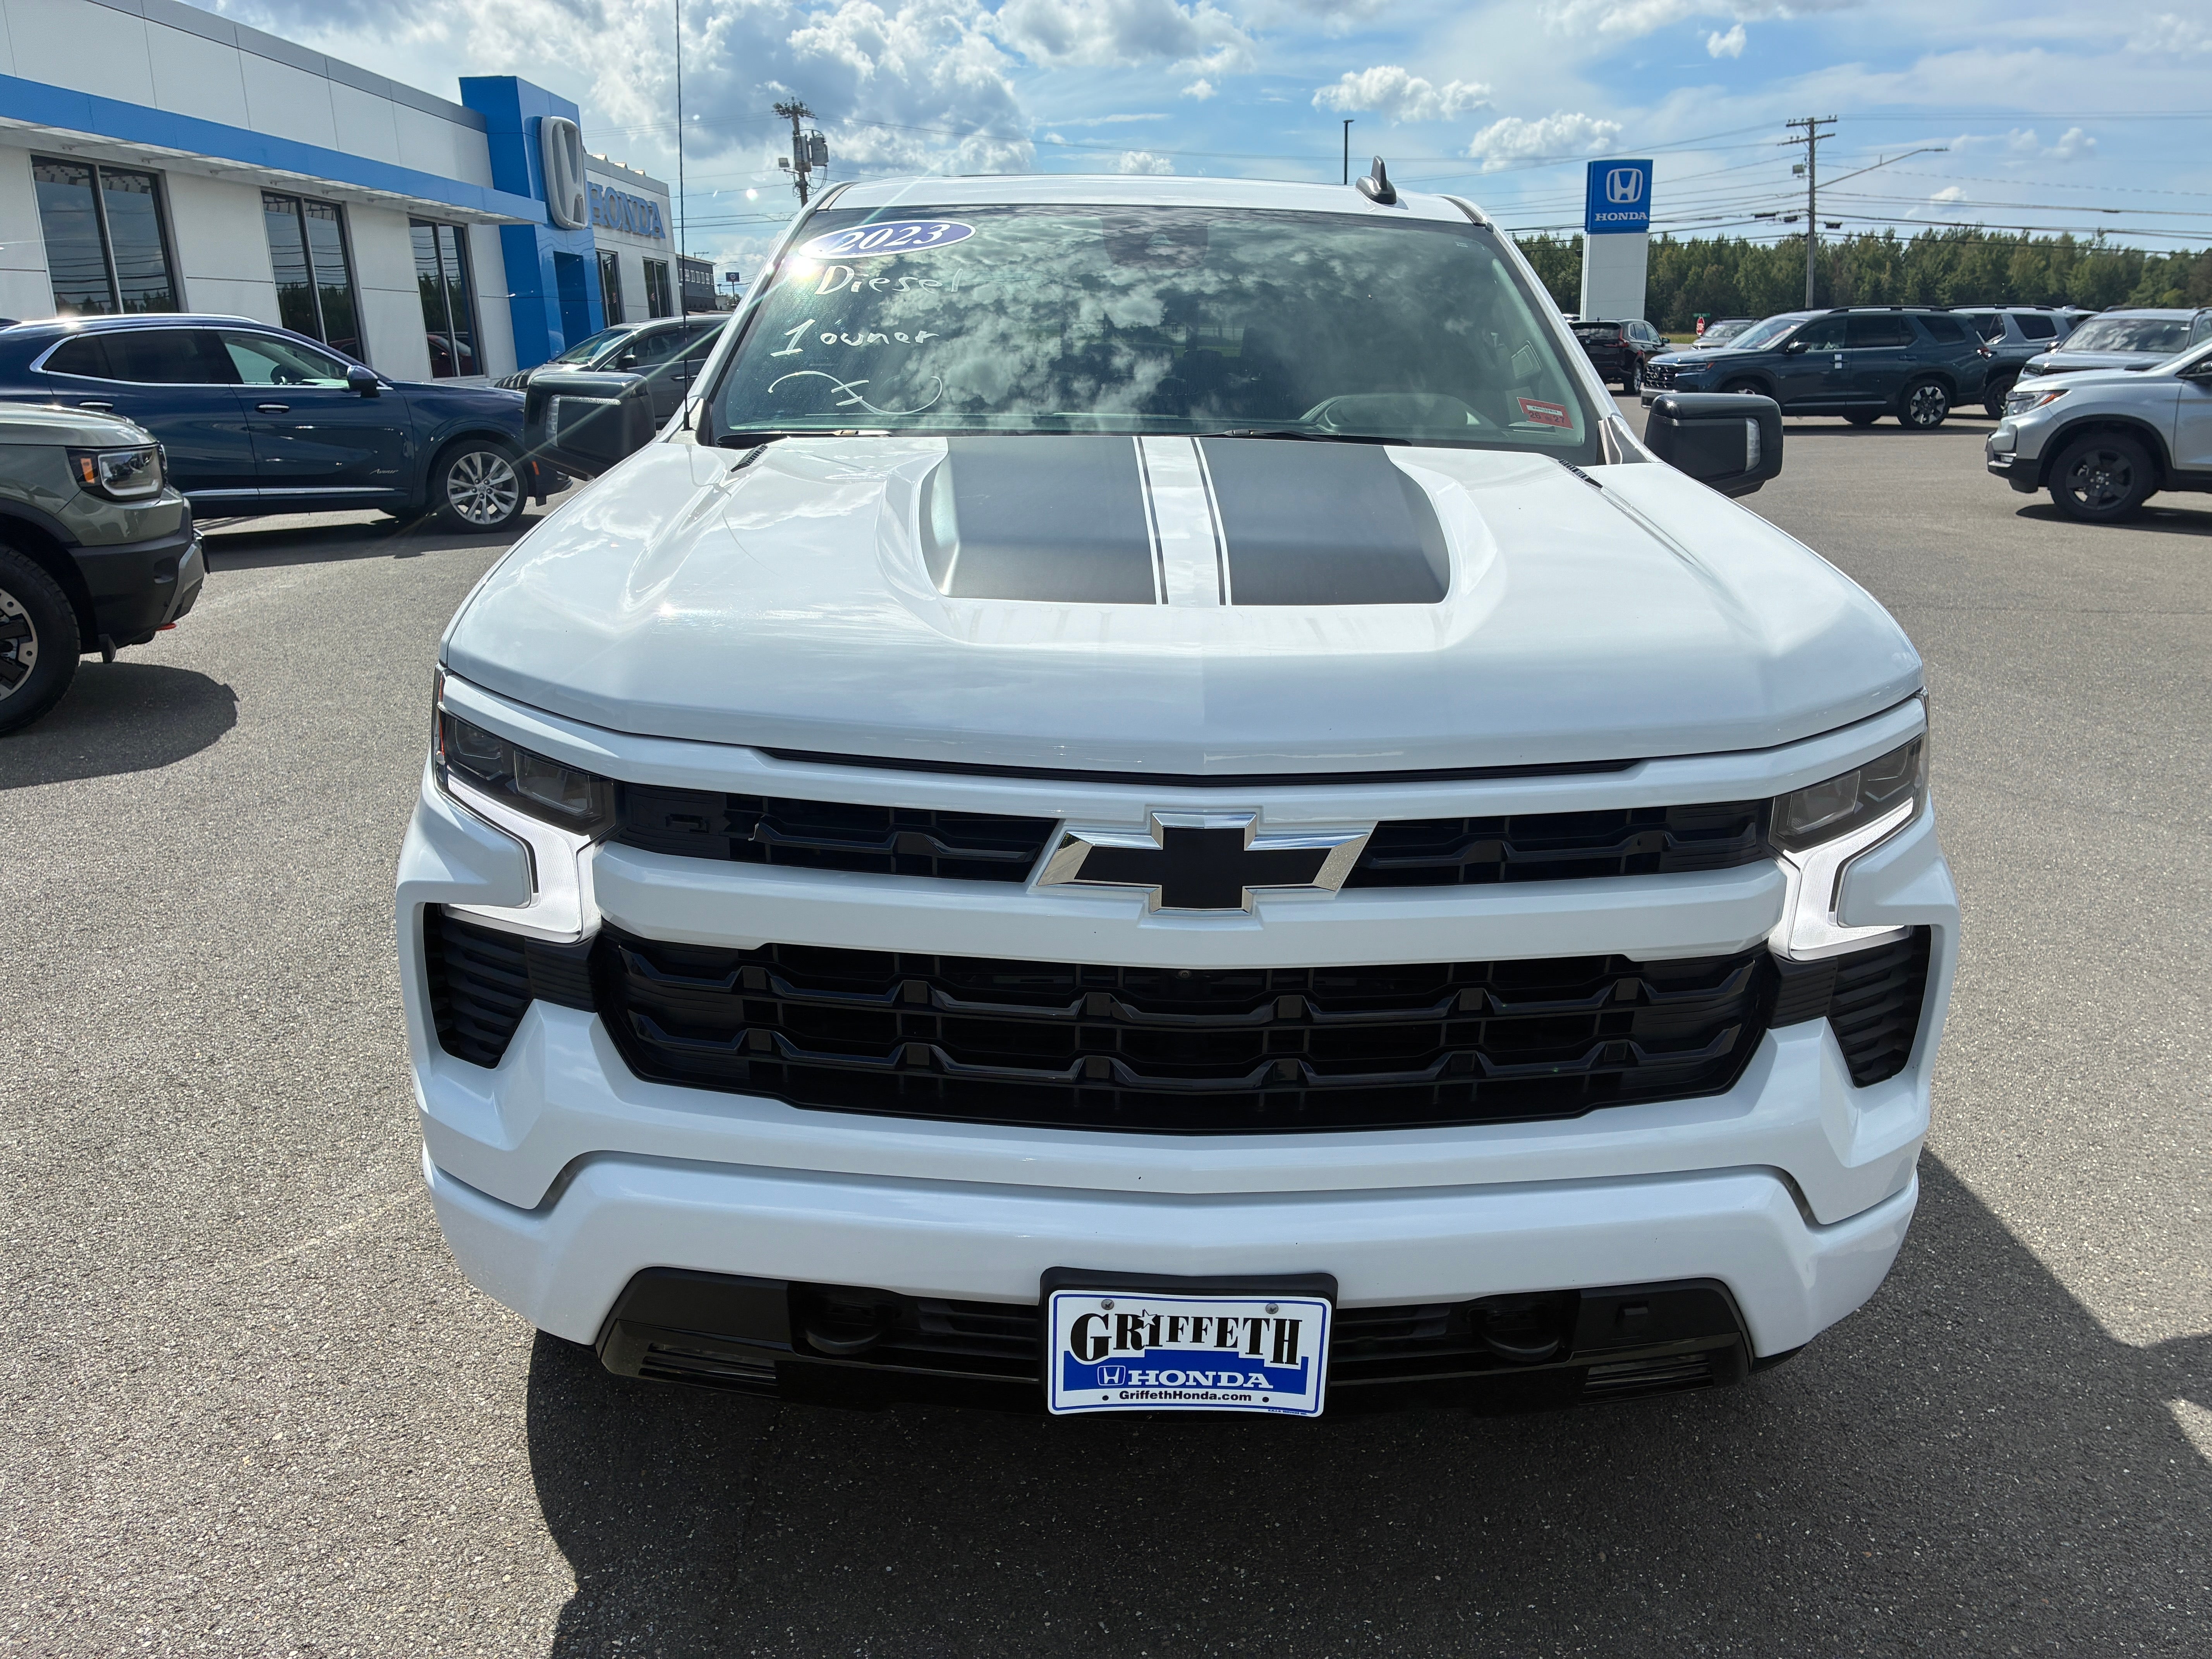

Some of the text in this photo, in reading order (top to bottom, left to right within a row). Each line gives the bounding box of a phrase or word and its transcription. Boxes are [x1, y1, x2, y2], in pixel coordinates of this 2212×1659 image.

[587, 181, 666, 239] HONDA
[1595, 212, 1648, 221] HONDA
[826, 224, 950, 254] 2023
[814, 265, 963, 295] Diesel
[770, 319, 939, 357] 1 owner
[1070, 1313, 1302, 1365] GRIFFETH
[1128, 1370, 1273, 1389] HONDA
[1119, 1390, 1252, 1401] GriffethHonda.com
